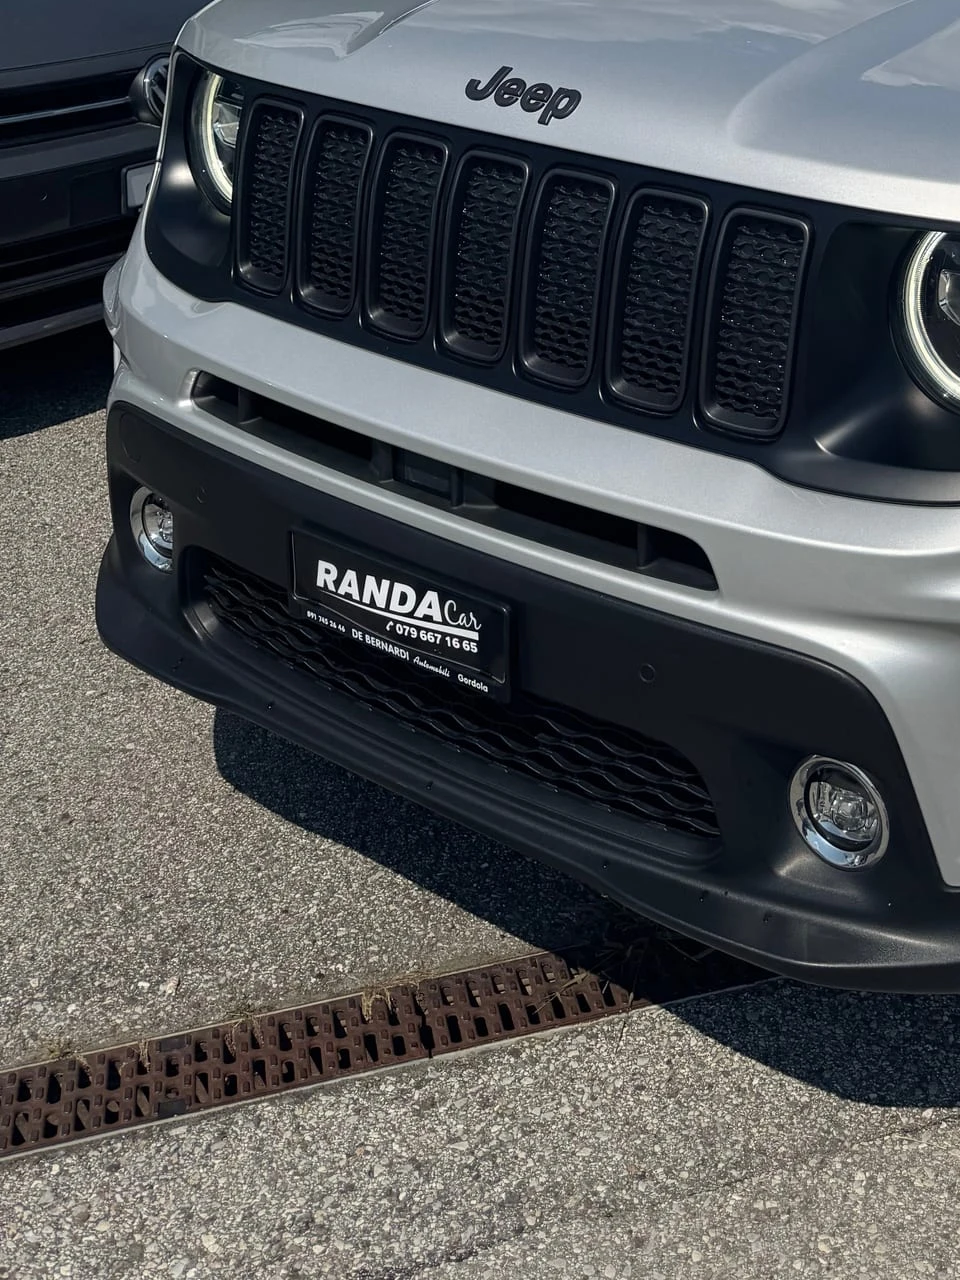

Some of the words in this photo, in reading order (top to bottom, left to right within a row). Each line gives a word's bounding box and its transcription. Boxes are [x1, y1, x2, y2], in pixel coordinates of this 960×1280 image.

[465, 65, 582, 126] Jeep
[316, 559, 442, 623] RANDA
[444, 599, 482, 631] Car
[306, 610, 317, 621] 091
[351, 628, 364, 641] DE
[365, 634, 410, 661] BERNARDI
[413, 655, 451, 678] Automobili
[457, 673, 489, 693] Gordola
[395, 623, 417, 639] 079
[419, 630, 442, 644] 667
[445, 636, 460, 649] 16
[462, 640, 478, 653] 65
